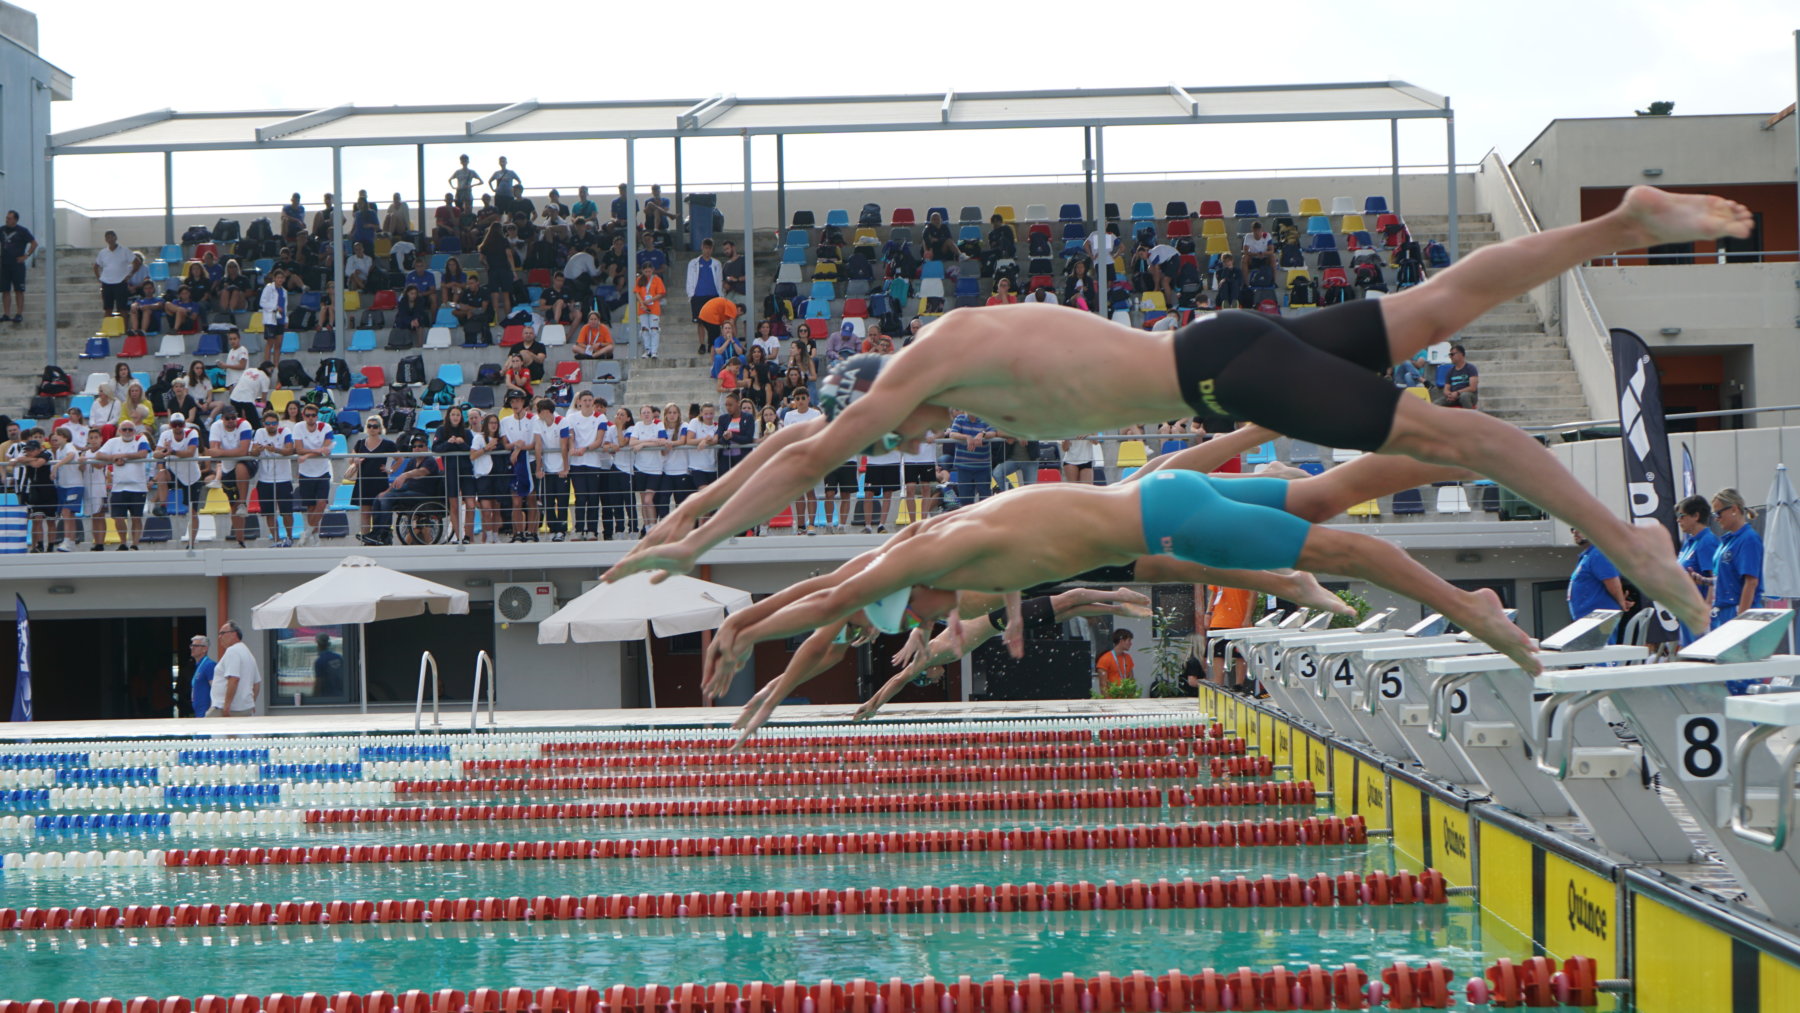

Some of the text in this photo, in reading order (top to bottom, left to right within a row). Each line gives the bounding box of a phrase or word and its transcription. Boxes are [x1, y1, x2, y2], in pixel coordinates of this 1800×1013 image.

[1300, 653, 1317, 678] 3
[1334, 658, 1354, 686] 4
[1380, 665, 1402, 698] 5
[1683, 717, 1722, 778] 8
[1366, 775, 1383, 809] Quince
[1443, 815, 1466, 859] Quince
[1568, 878, 1607, 941] Quince
